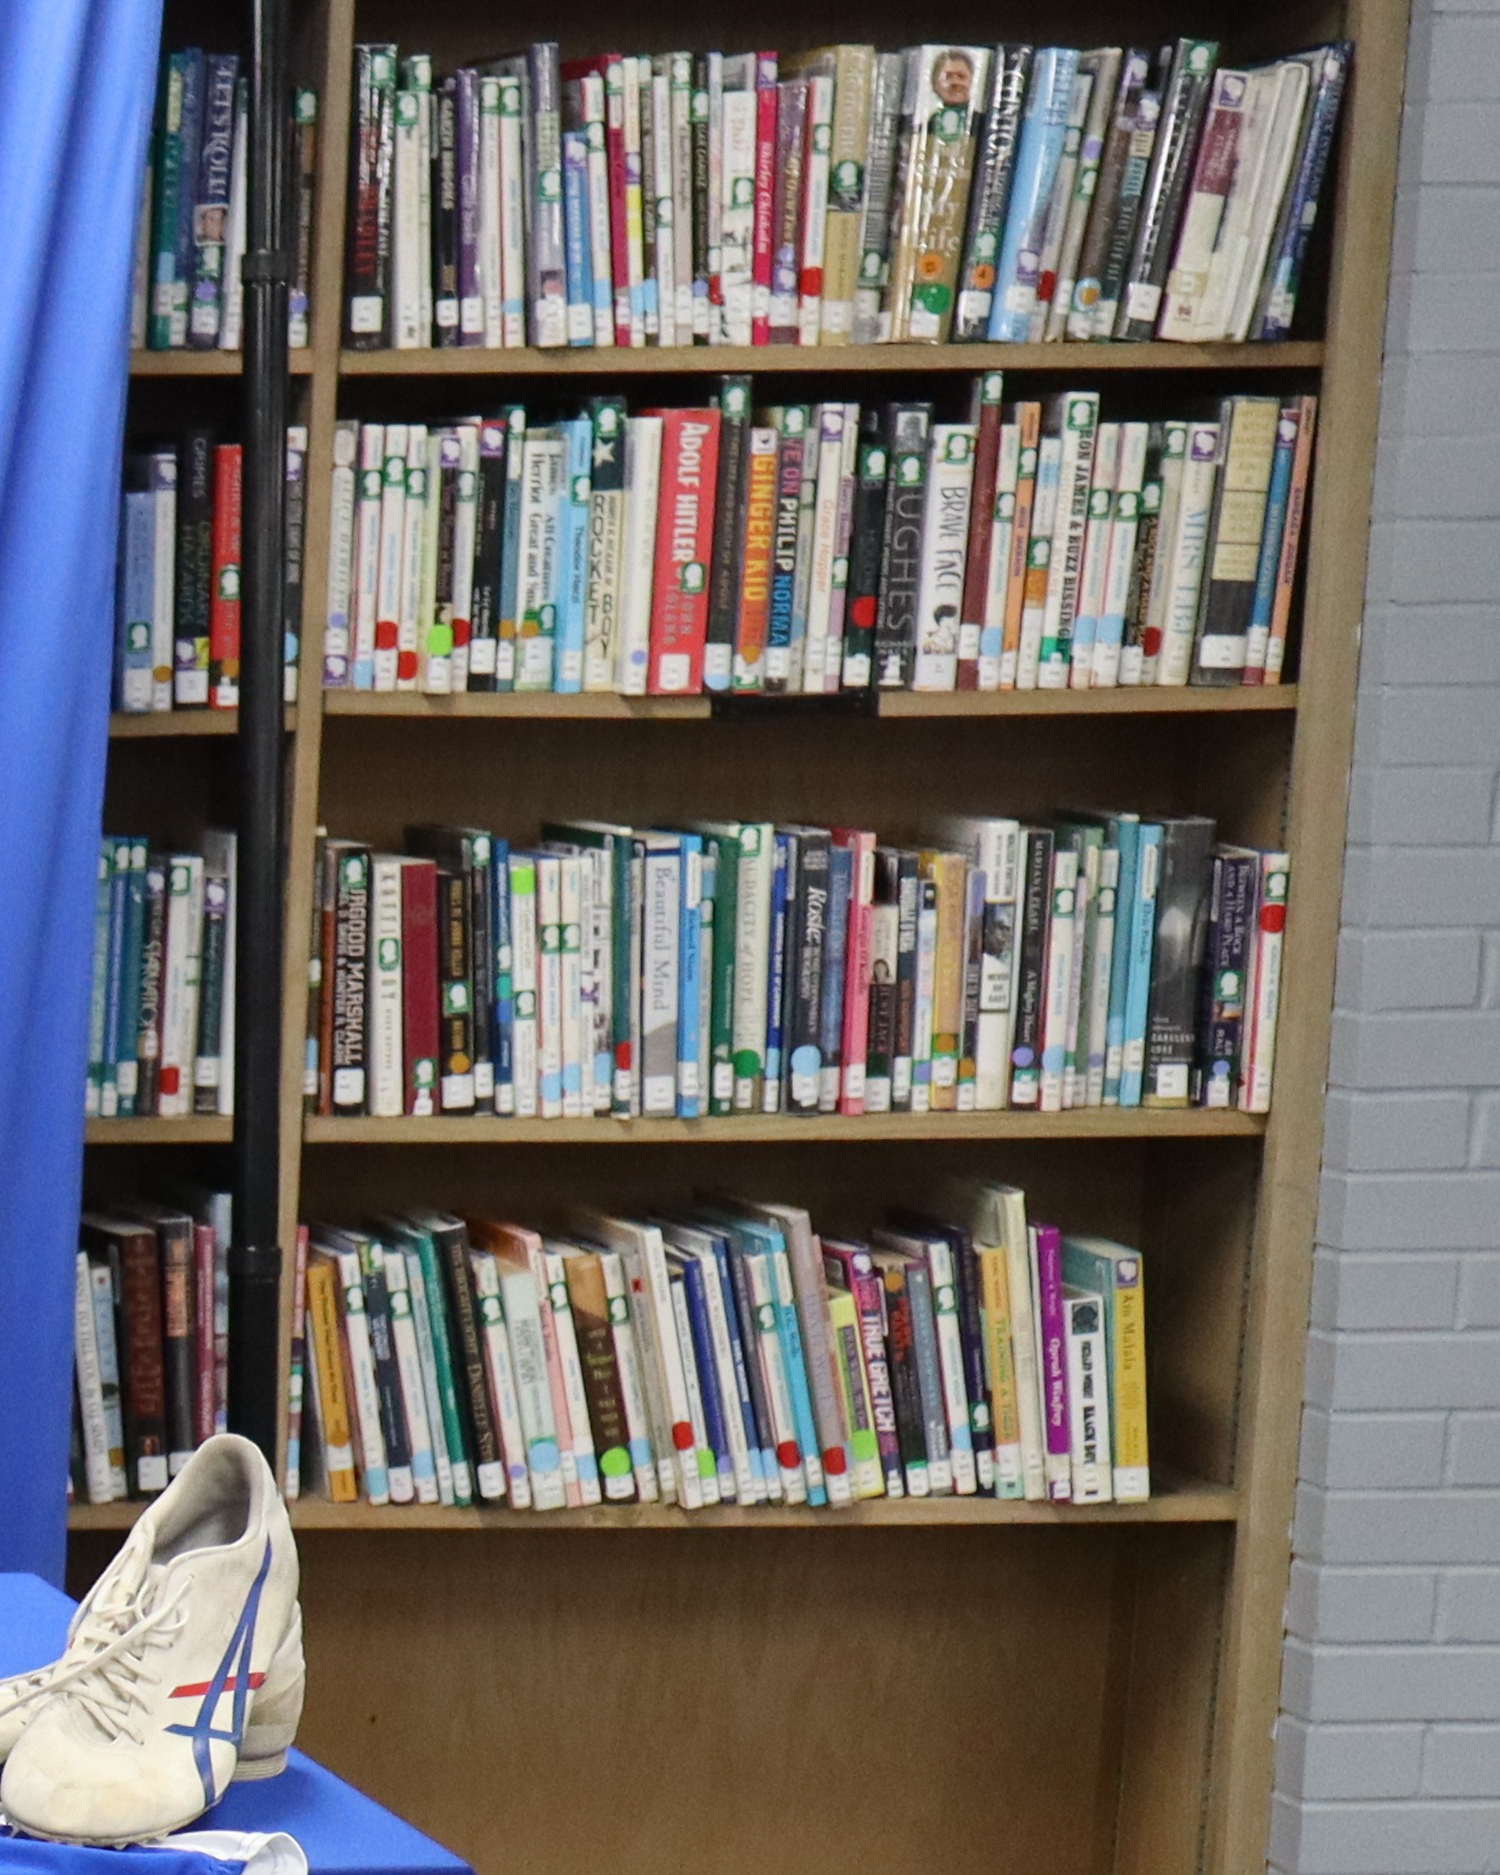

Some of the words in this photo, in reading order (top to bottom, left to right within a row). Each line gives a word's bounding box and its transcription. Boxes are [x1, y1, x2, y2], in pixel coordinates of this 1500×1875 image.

[758, 141, 773, 188] Shirley
[756, 190, 771, 254] Chisholm
[192, 437, 207, 499] GRIMES
[531, 453, 545, 504] Herriot
[548, 453, 562, 496] James
[679, 421, 710, 487] ADOLF
[747, 455, 776, 550] GINGER
[781, 466, 802, 494] ON
[1072, 464, 1090, 516] JAMES
[527, 513, 542, 548] Great
[543, 513, 556, 534] All
[671, 493, 700, 562] HITLER
[776, 497, 799, 573] PHILIP
[819, 499, 835, 539] Grace
[940, 486, 967, 540] BRAVE
[527, 551, 541, 578] and
[541, 536, 555, 601] Creatures
[589, 495, 605, 625] ROCKET
[815, 544, 832, 593] Hopper
[887, 493, 922, 631] UGHES
[934, 550, 960, 593] FACE
[1065, 535, 1085, 573] BUZZ
[744, 559, 769, 602] KID
[600, 594, 614, 660] BOY
[1059, 577, 1078, 638] BISSING
[347, 888, 366, 957] RGOOD
[381, 872, 397, 936] KAFFI
[652, 866, 673, 951] Beautiful
[743, 858, 758, 937] AUDACITY
[1028, 896, 1041, 932] PEARL
[1141, 903, 1153, 926] Elvis
[1232, 926, 1246, 954] ROCK
[651, 960, 672, 1011] Mind
[741, 962, 755, 1004] HOPE
[1023, 981, 1036, 1013] Mighty
[345, 962, 366, 1065] MARSHALL
[1122, 1294, 1134, 1318] Am
[862, 1313, 885, 1361] TRUE
[995, 1318, 1010, 1384] TRAINING
[1049, 1337, 1062, 1377] Oprah
[1122, 1322, 1136, 1371] Malala
[466, 1363, 486, 1427] DANIELLE
[476, 1431, 492, 1462] STEE
[868, 1361, 895, 1432] GRETCH
[1050, 1380, 1064, 1427] Winfrey
[1083, 1405, 1096, 1441] BLACK
